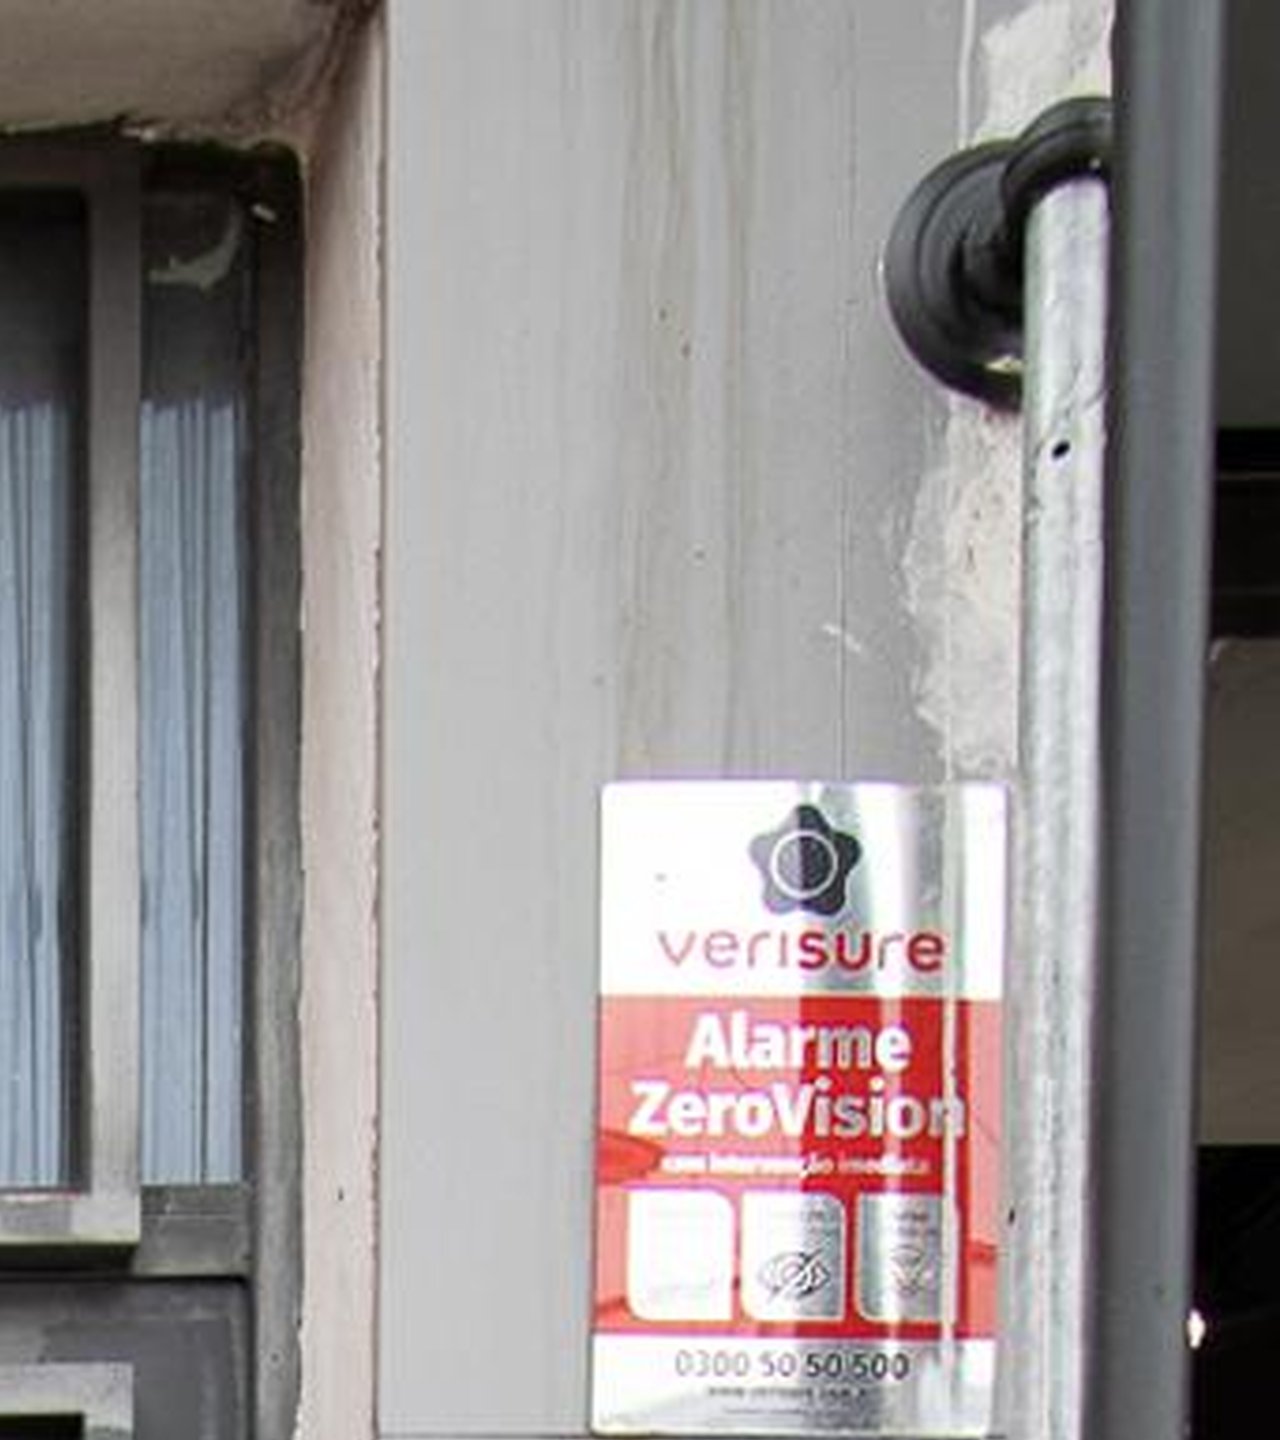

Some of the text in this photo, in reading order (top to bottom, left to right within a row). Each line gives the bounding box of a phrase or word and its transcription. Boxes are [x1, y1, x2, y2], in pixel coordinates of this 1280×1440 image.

[657, 928, 945, 972] verisure
[685, 1010, 912, 1072] Alarme
[628, 1074, 967, 1138] ZeroVision
[675, 1349, 750, 1377] 0300
[806, 1351, 842, 1378] 50
[853, 1352, 910, 1380] 500
